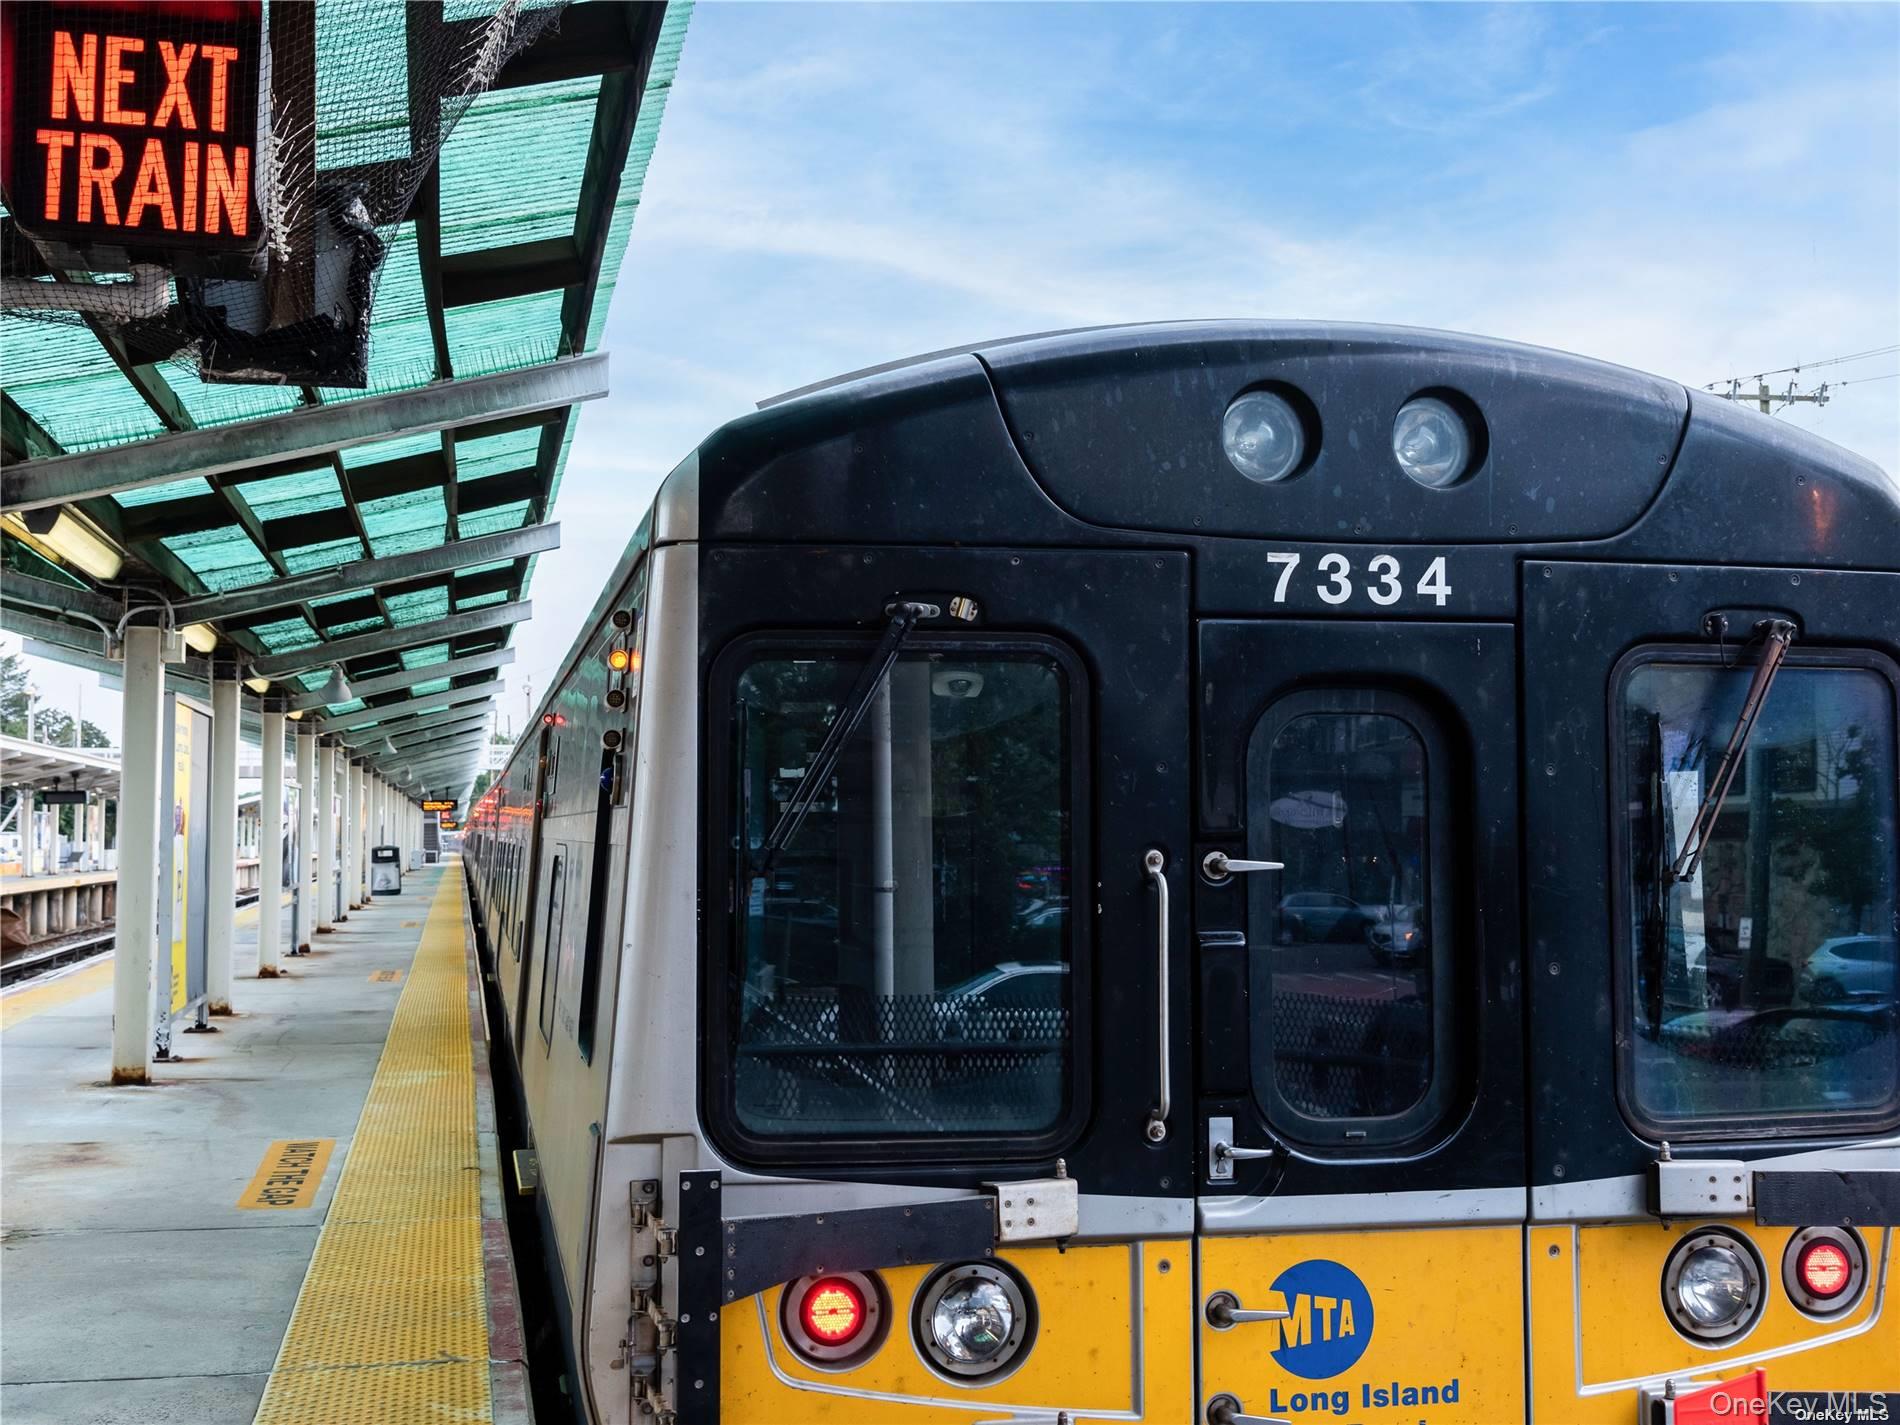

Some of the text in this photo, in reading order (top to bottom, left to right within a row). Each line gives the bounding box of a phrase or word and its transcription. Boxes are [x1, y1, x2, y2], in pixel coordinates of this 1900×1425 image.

[51, 31, 239, 132] NEXT
[36, 129, 249, 236] TRAIN
[1266, 552, 1452, 606] 7334
[256, 1141, 321, 1206] WATCH THE GAP
[1269, 1289, 1356, 1350] MTA
[1270, 1379, 1460, 1416] Long Island
